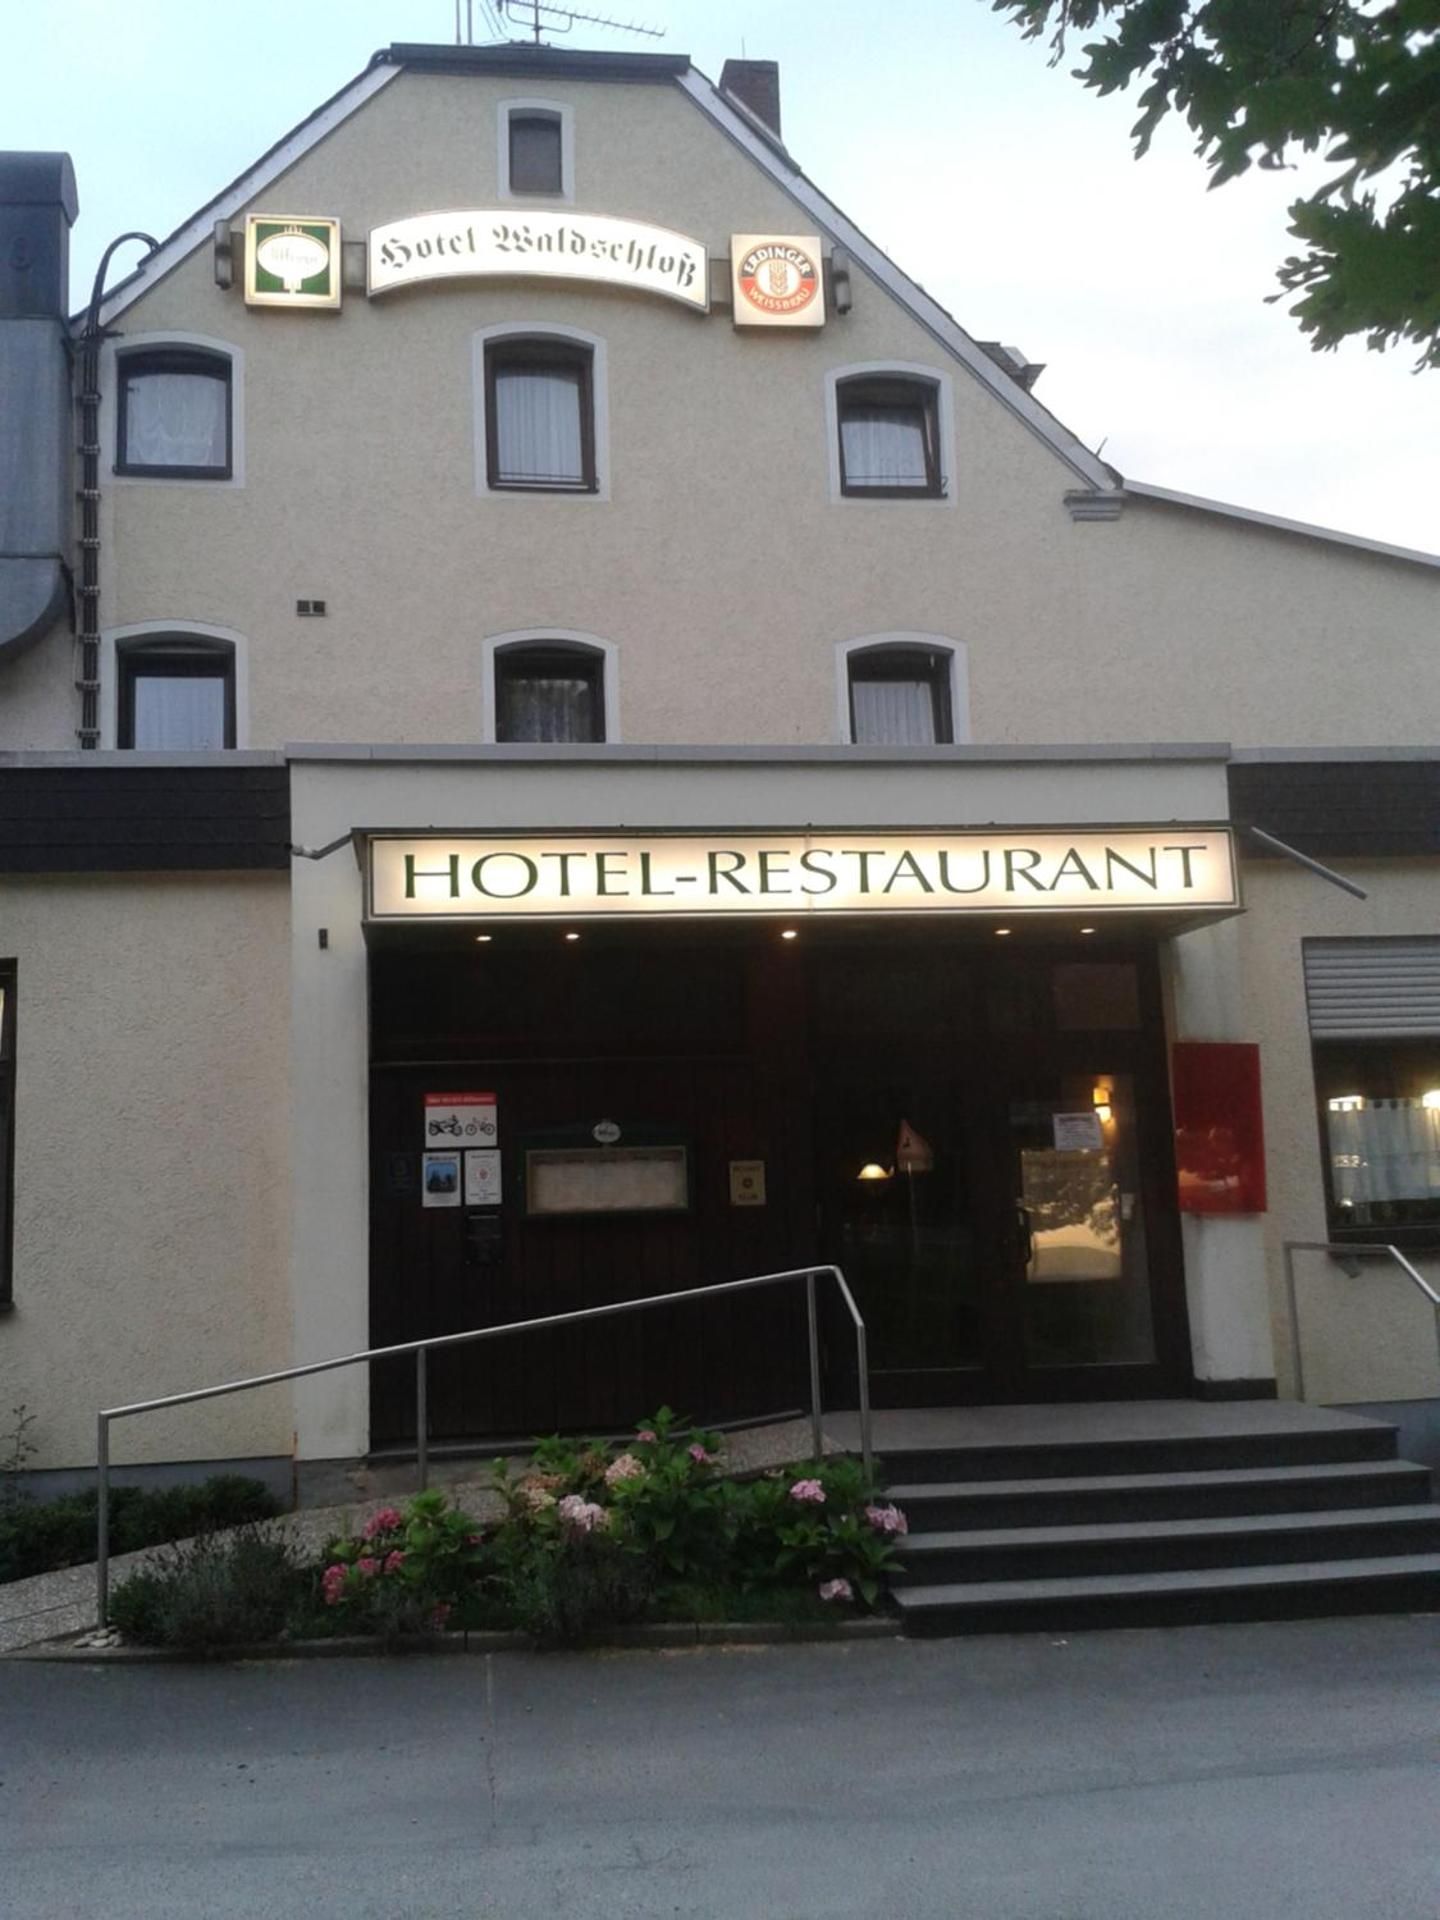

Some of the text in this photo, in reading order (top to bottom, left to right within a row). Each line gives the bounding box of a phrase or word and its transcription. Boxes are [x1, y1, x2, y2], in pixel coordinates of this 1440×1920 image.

[380, 227, 475, 269] Hotel
[743, 246, 812, 274] ERDINGER
[404, 846, 1208, 900] HOTEL-RESTAURANT
